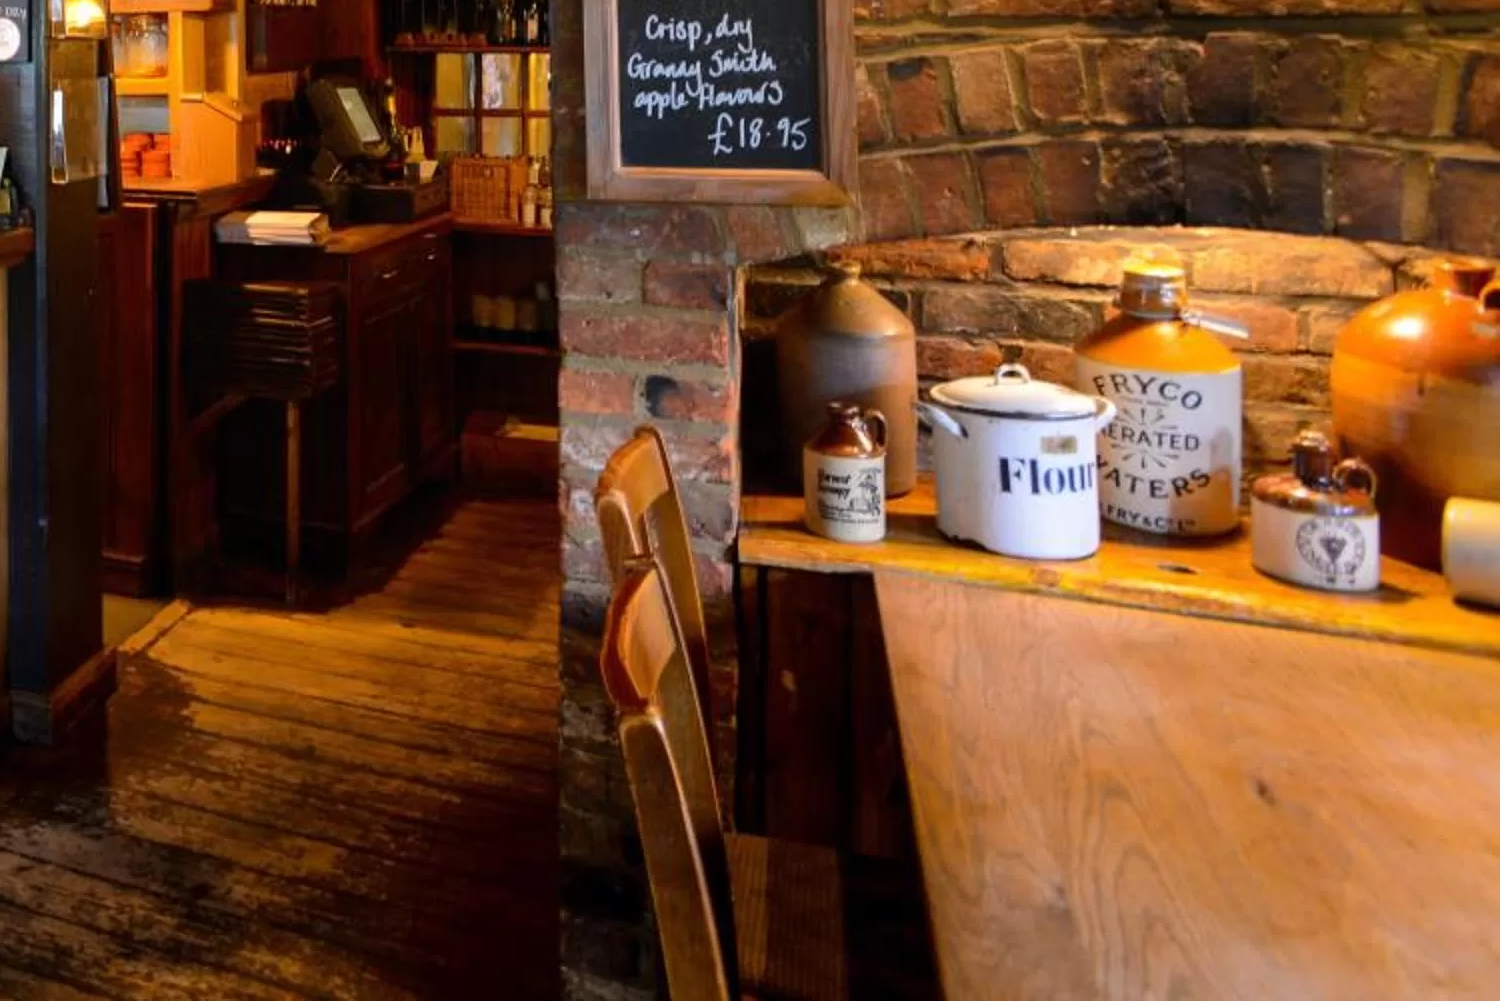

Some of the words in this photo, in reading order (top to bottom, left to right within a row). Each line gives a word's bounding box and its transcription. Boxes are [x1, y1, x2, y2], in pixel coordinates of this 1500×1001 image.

[715, 13, 753, 53] dry
[628, 53, 701, 96] Granny
[709, 49, 776, 77] Smith
[634, 81, 688, 119] apple
[1093, 373, 1203, 410] FRYCO
[999, 457, 1095, 495] Flour
